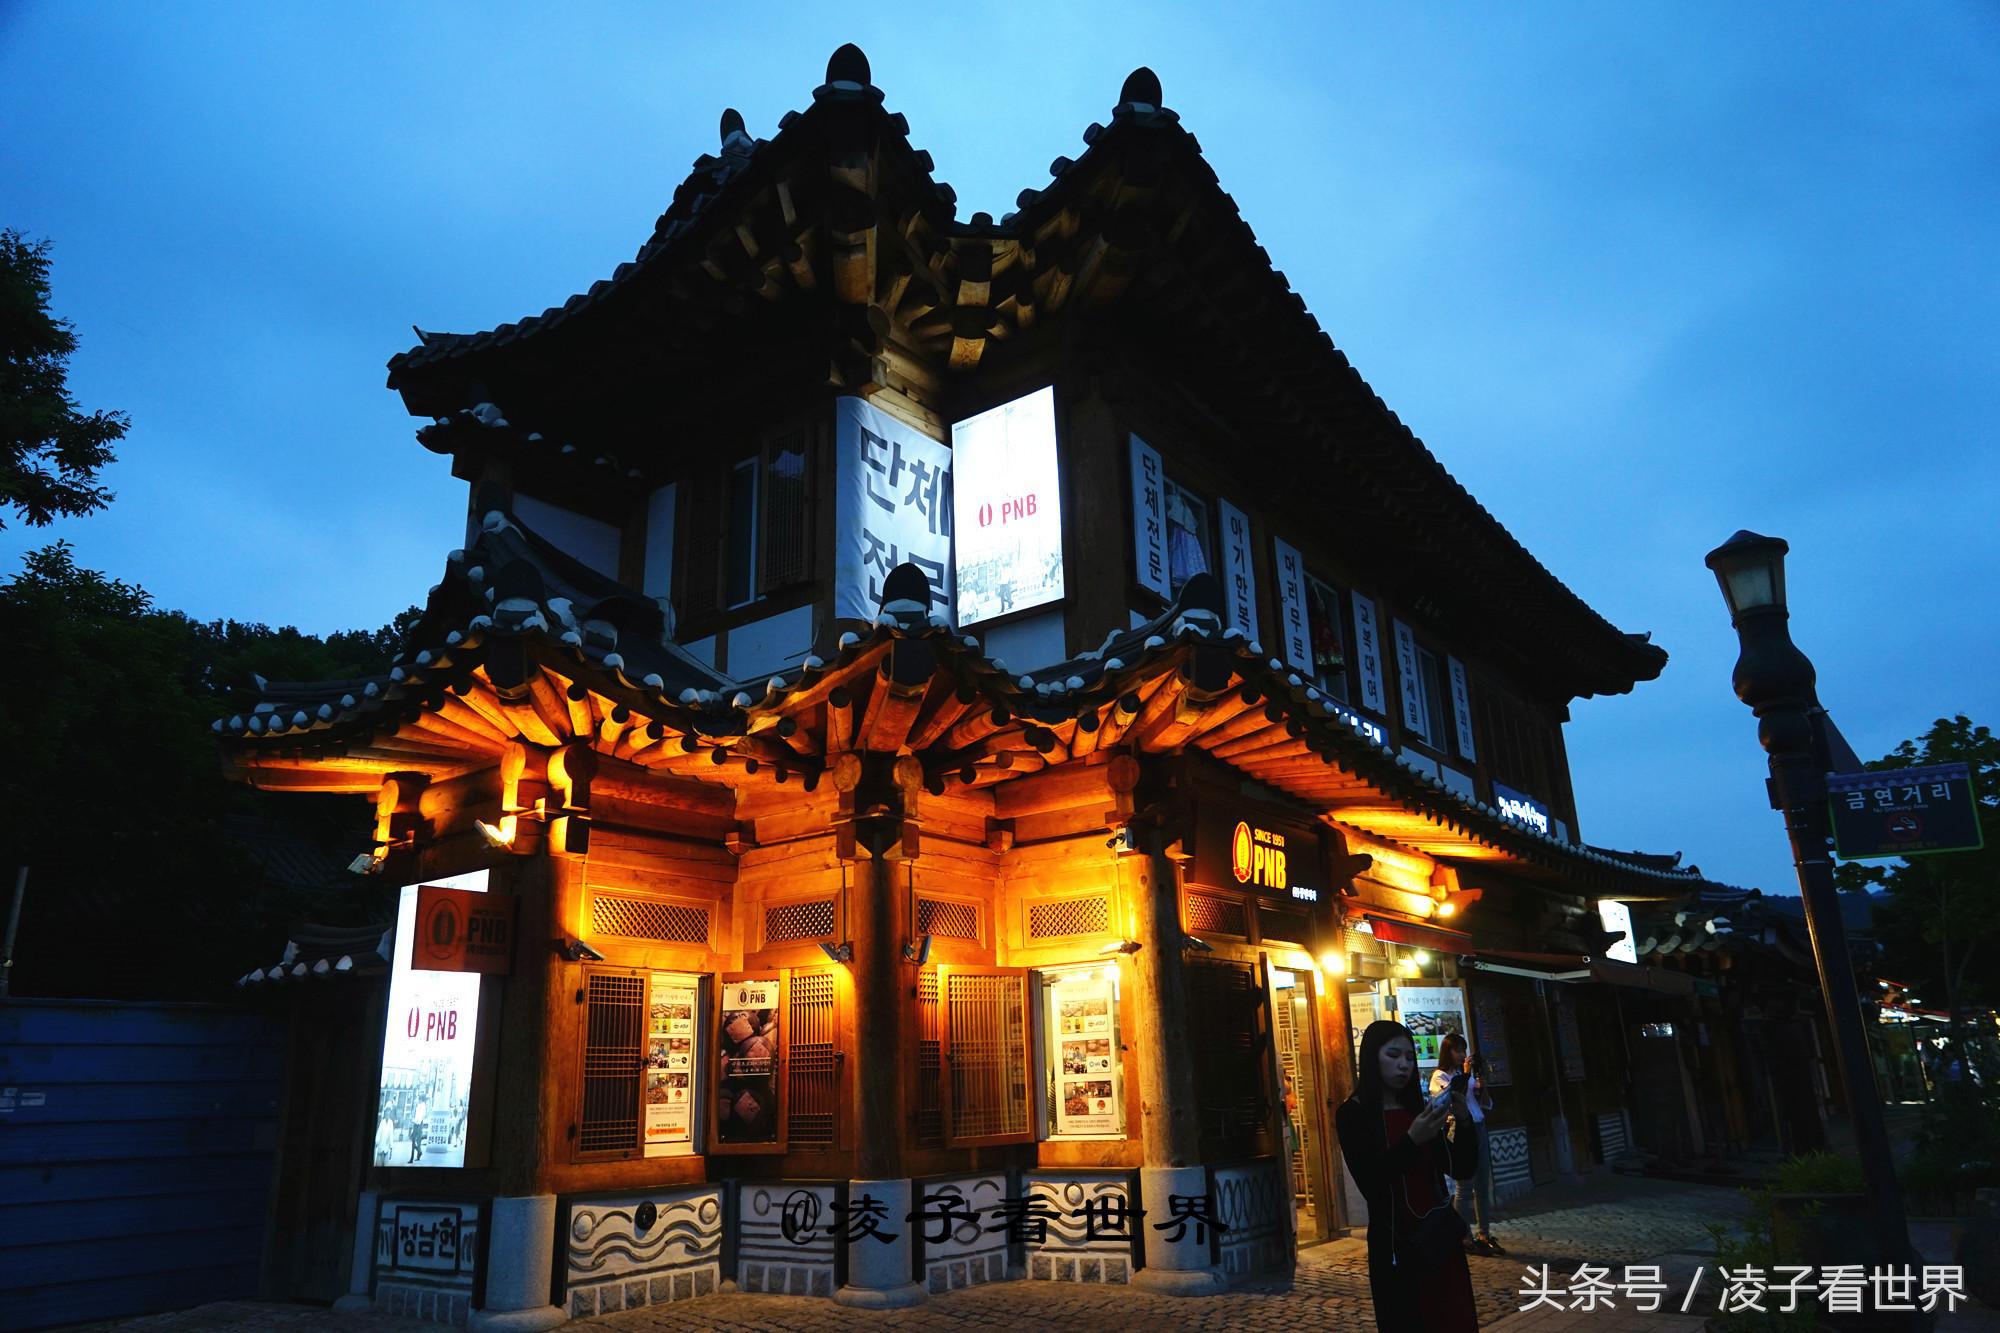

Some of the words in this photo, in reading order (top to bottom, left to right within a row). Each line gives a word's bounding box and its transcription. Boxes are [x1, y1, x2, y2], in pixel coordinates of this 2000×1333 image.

[861, 426, 950, 537] 단체
[1001, 493, 1037, 526] PNB
[1142, 452, 1163, 584] 단체전문
[1230, 515, 1251, 633] 아기한복
[1284, 552, 1305, 661] 머리무료
[1360, 603, 1379, 704] 교복대여
[1845, 782, 1952, 811] 금연거리
[1254, 828, 1271, 843] SINCE
[1272, 833, 1285, 847] 1951
[1253, 844, 1287, 889] PNB
[468, 917, 506, 945] PNB
[750, 993, 766, 1004] PNB
[426, 1010, 457, 1041] PNB
